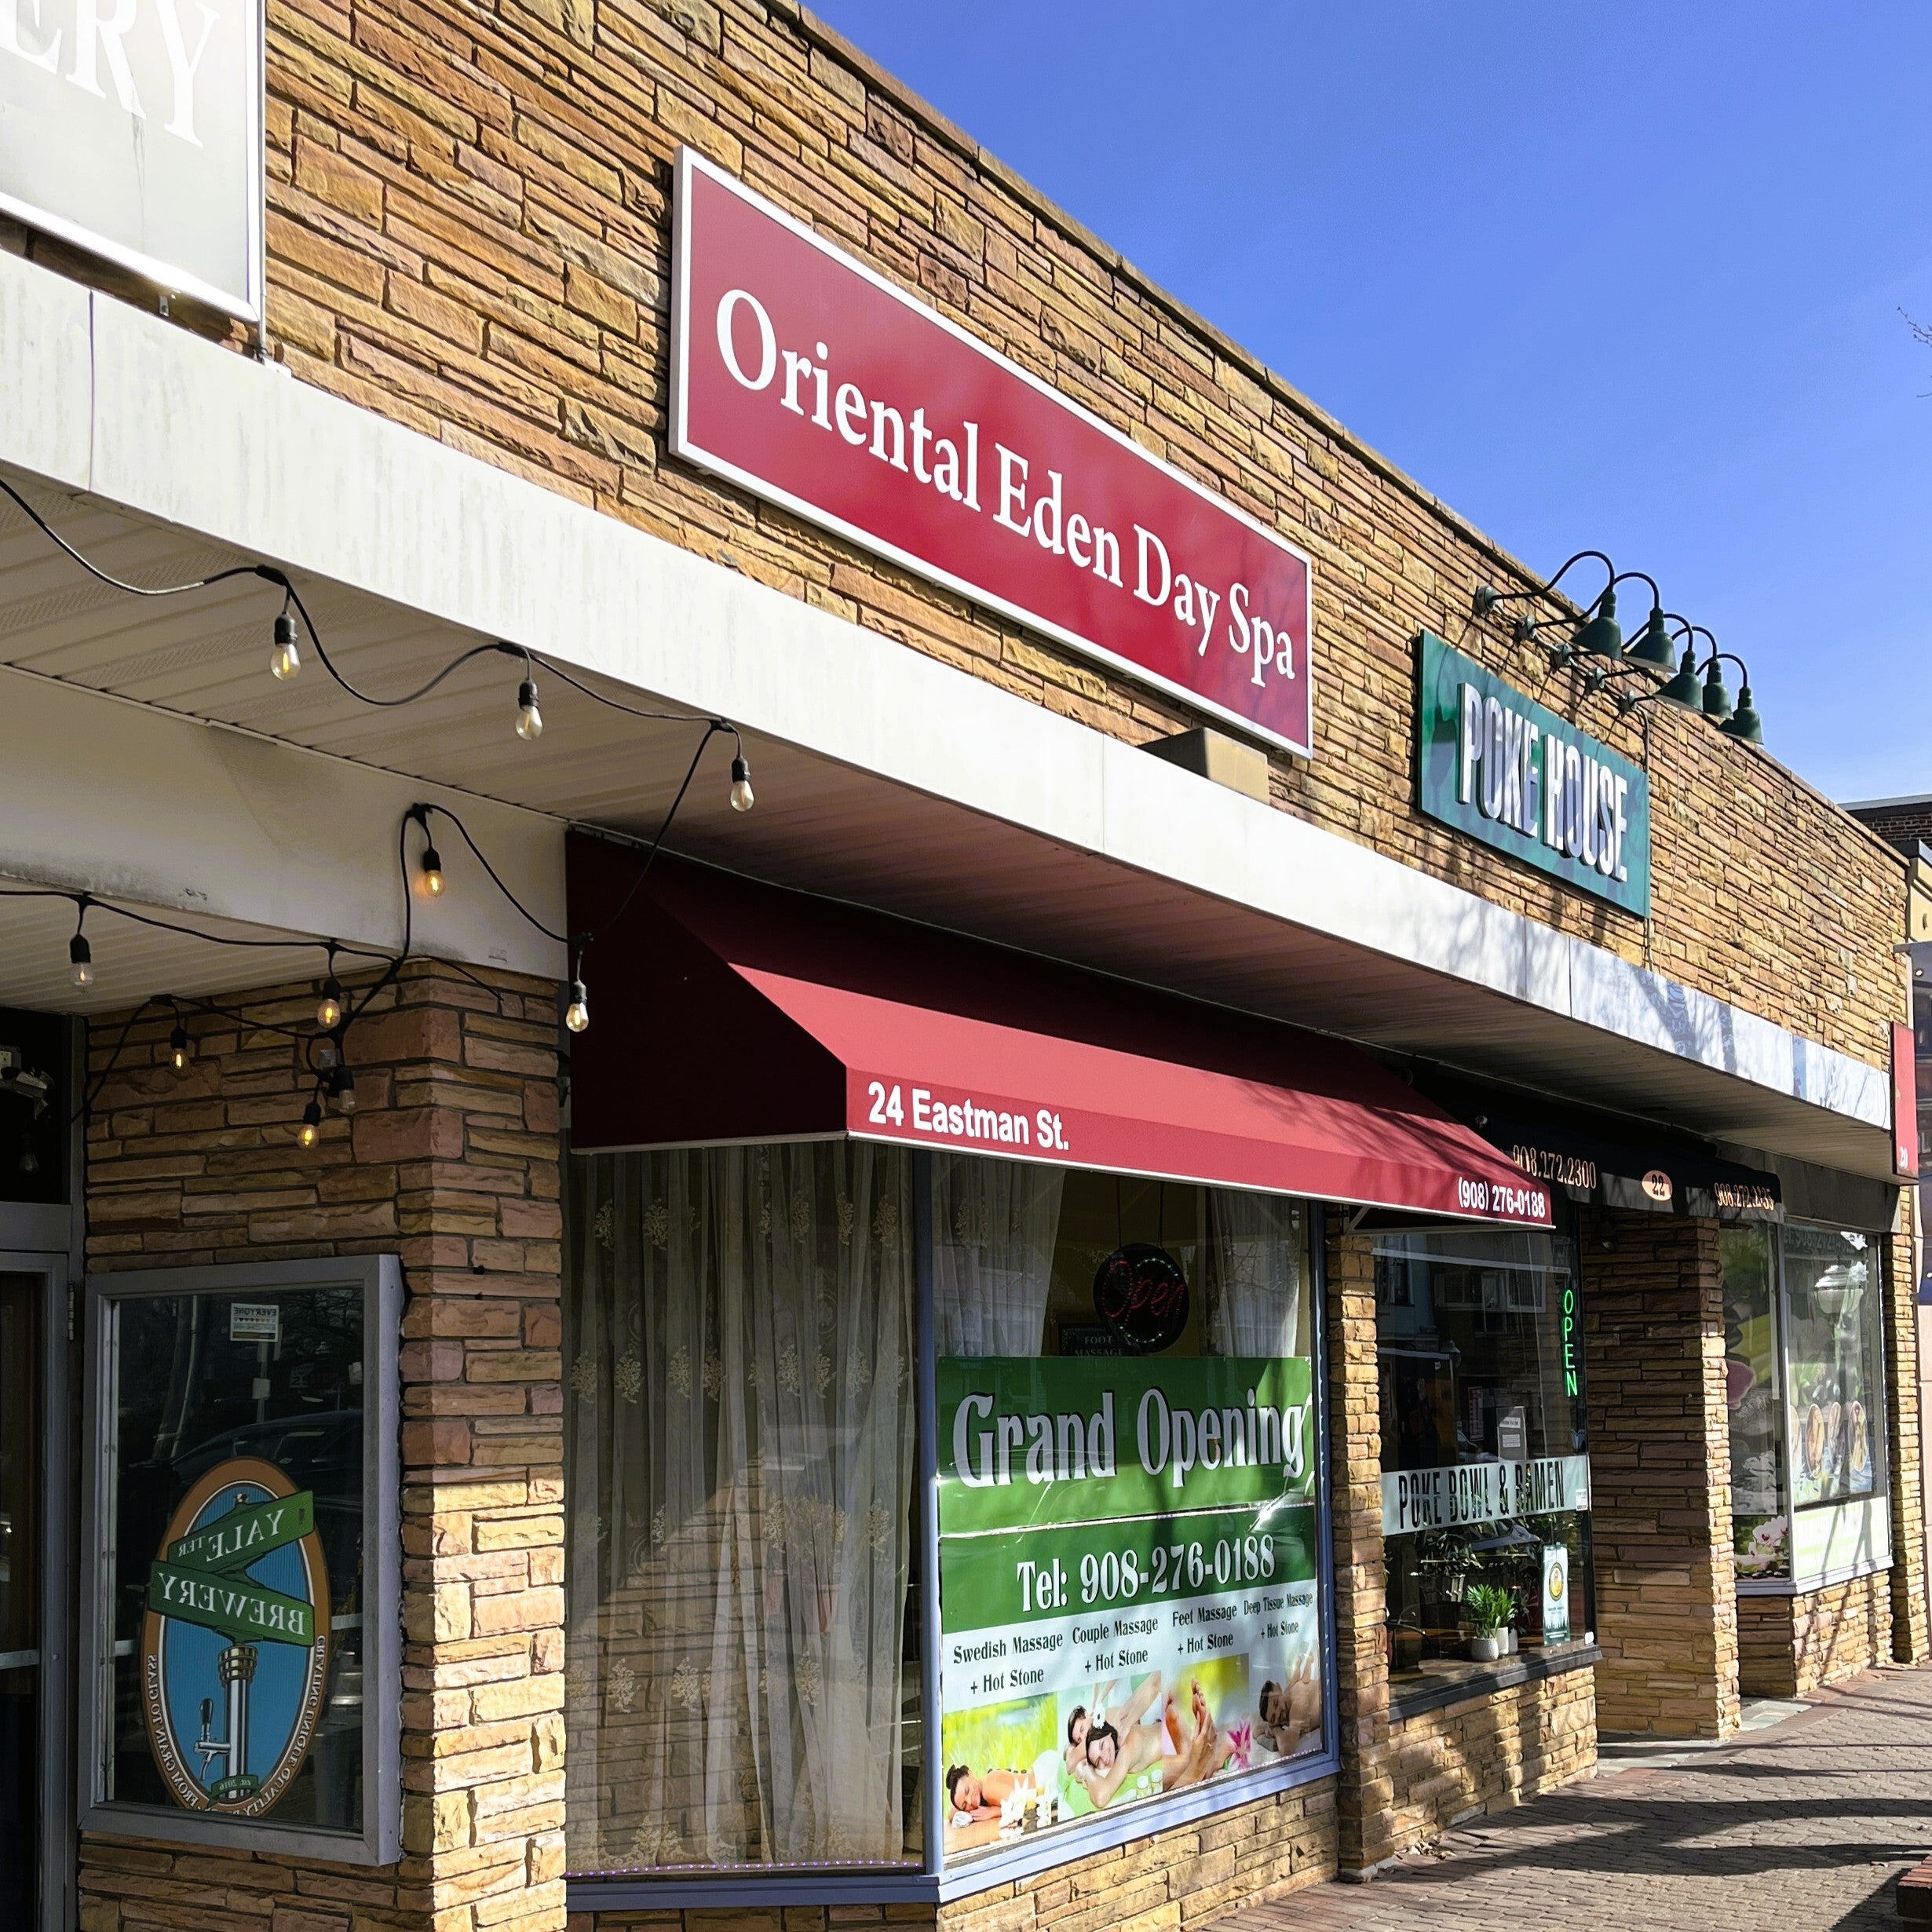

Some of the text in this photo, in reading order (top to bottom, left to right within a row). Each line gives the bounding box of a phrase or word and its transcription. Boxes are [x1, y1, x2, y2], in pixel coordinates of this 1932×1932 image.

[716, 288, 1296, 688] Oriental Eden Day Spa
[1458, 682, 1627, 883] POKE HOUSE
[868, 1081, 1069, 1151] 24 Eastman St.
[1513, 1145, 1597, 1189] 908.272.2300
[1900, 1146, 1908, 1168] 20
[1458, 1176, 1546, 1218] (908) 276-0188
[1651, 1174, 1665, 1196] 22
[1102, 1260, 1186, 1325] Open
[1075, 1348, 1124, 1357] MASSAGE
[1084, 1335, 1112, 1345] FOOT
[1564, 1289, 1578, 1397] OPEN
[952, 1387, 1309, 1488] Grand Opening
[1398, 1460, 1565, 1529] POKE BOWL & RAMEN
[1017, 1534, 1276, 1612] Tel: 908-276-0188
[1172, 1604, 1237, 1627] Feet Massage
[1244, 1592, 1313, 1616] Deep Tissue Massage
[1072, 1617, 1158, 1645] Couple Massage
[1187, 1637, 1203, 1654] Hot
[1207, 1633, 1234, 1650] Stone
[1267, 1623, 1279, 1639] Hot
[1280, 1621, 1299, 1635] Stone
[953, 1633, 1063, 1664] Swedish Massage
[1095, 1653, 1114, 1671] Hot
[1119, 1649, 1149, 1667] Stone
[983, 1673, 1004, 1693] Hot
[1010, 1668, 1044, 1688] Stone
